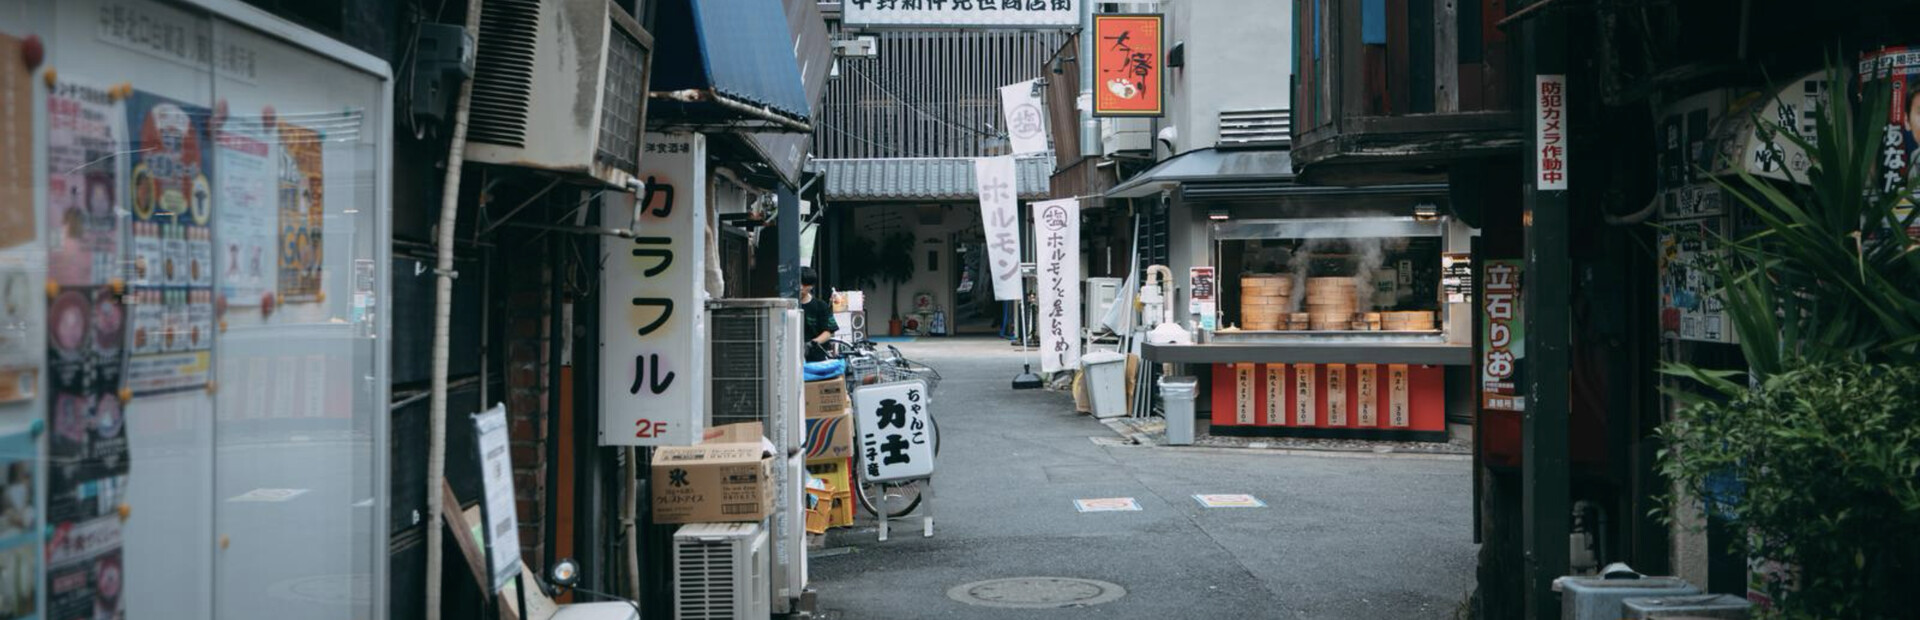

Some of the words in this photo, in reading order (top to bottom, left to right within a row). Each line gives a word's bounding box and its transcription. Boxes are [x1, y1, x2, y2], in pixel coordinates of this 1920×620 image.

[645, 142, 690, 153] 洋食酒場
[1541, 81, 1563, 185] 防犯カメラ作動中
[982, 177, 1020, 281] ホルモン
[630, 175, 675, 395] カラフル
[1486, 264, 1513, 377] 立石りお
[635, 418, 668, 438] 2F
[876, 398, 911, 466] 力士
[907, 388, 925, 445] ちゃんこ
[668, 468, 690, 488] 氷
